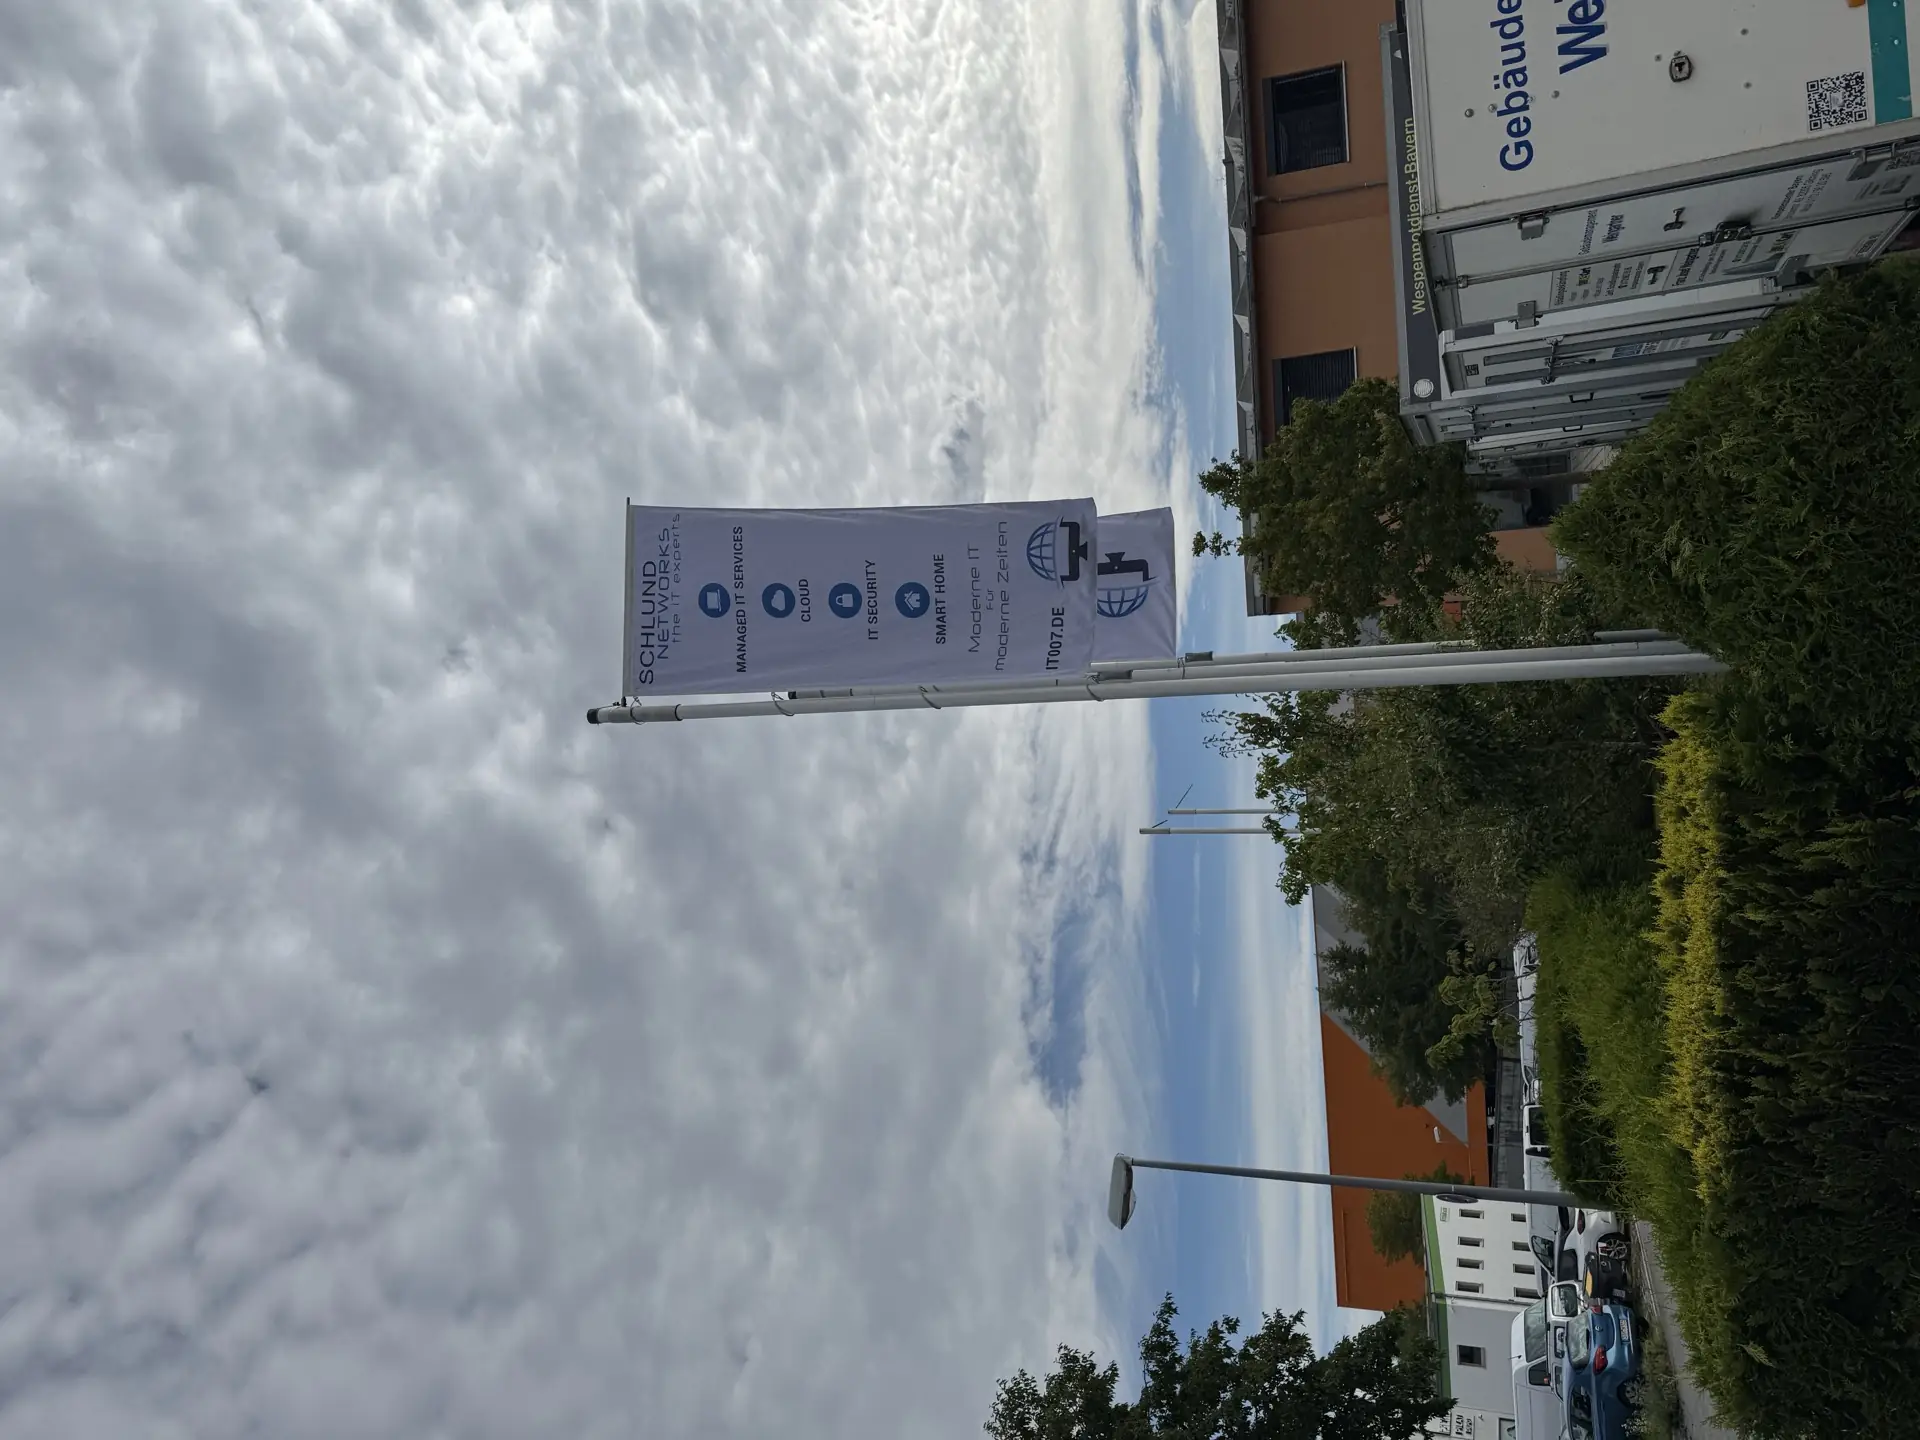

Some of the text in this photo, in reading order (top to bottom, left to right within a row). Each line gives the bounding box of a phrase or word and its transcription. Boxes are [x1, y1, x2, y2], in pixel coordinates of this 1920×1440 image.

[1554, 0, 1608, 75] We
[639, 560, 656, 685] SCHLUND
[657, 527, 671, 659] NETWORKS
[671, 512, 682, 643] the IT experts
[732, 525, 747, 673] MANAGED IT SERVICES
[798, 578, 811, 623] CLOUD
[864, 559, 879, 640] IT SECURITY
[933, 553, 947, 645] SMART HOME
[966, 542, 982, 653] Moderne IT
[994, 521, 1010, 671] moderne Zeiten
[1045, 607, 1065, 670] IT007.DE
